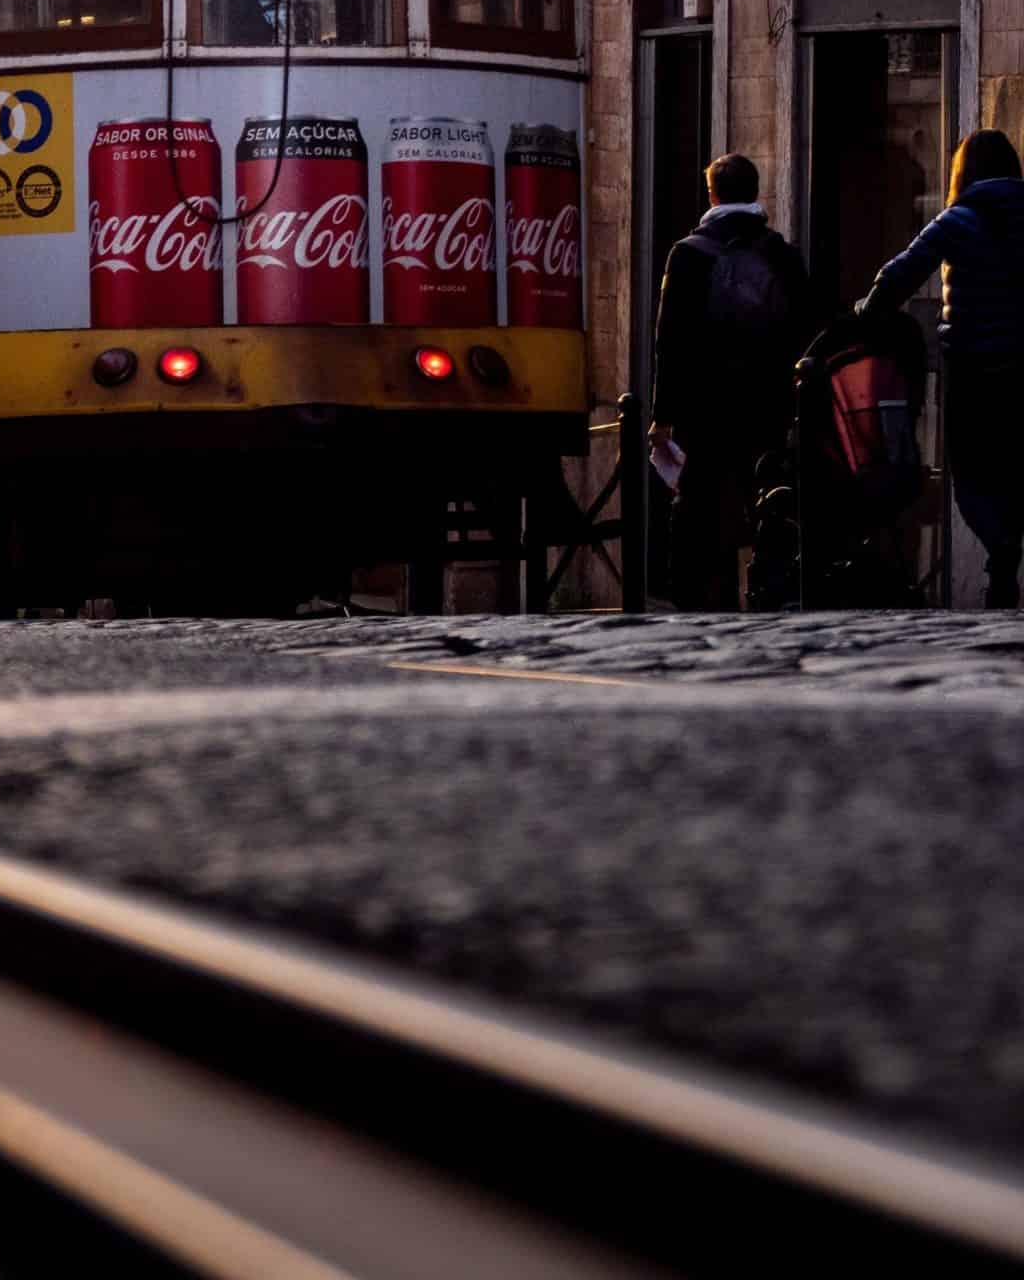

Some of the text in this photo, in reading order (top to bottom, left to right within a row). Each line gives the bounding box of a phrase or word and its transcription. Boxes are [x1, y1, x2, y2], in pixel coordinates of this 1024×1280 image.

[96, 126, 215, 146] SABOR ORGINAL
[246, 122, 358, 143] SEM AÇÚCAR
[390, 127, 486, 144] SABOR LIGHT
[112, 149, 158, 161] DESDE
[253, 146, 353, 158] SEM CALORIAS
[398, 148, 482, 160] SEM CALORIAS
